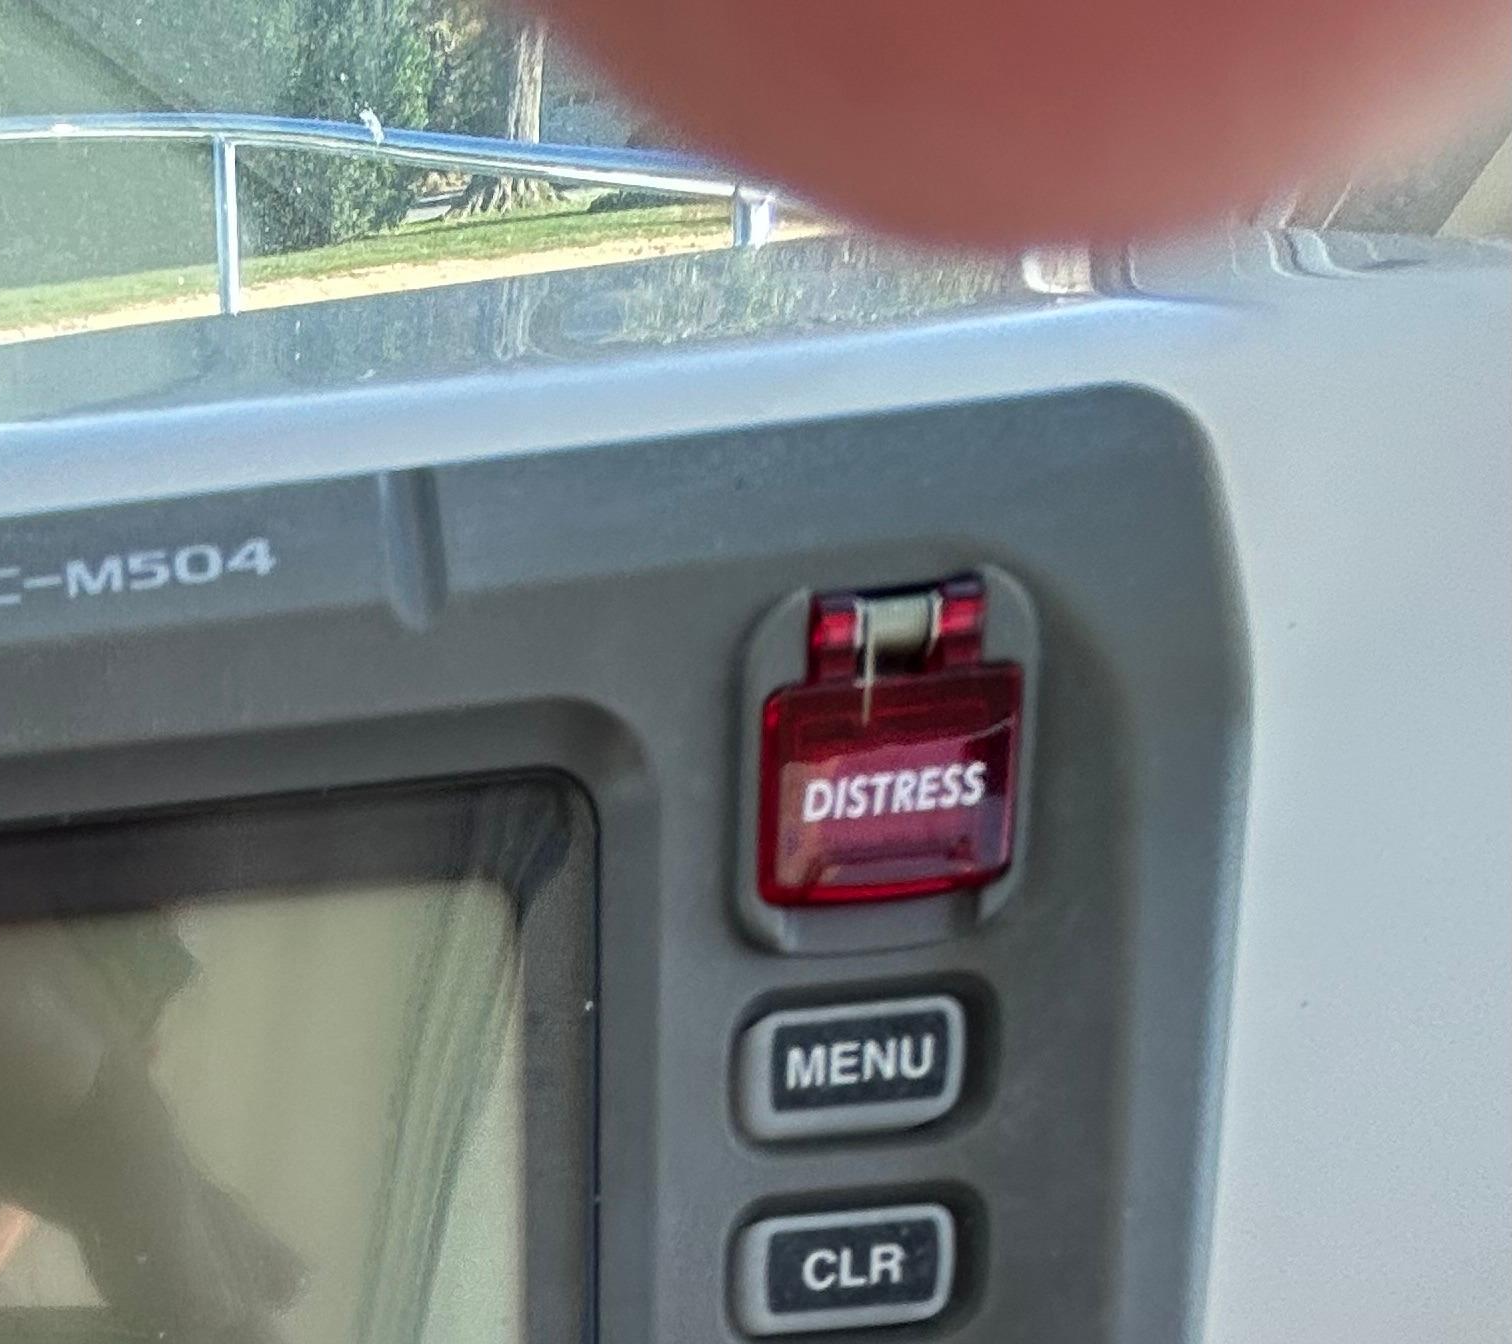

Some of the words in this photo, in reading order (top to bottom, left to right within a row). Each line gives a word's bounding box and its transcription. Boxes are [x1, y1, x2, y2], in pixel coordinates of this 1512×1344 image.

[801, 760, 989, 824] DISTRESS
[784, 1031, 937, 1091] MENU
[801, 1242, 906, 1292] CLR
